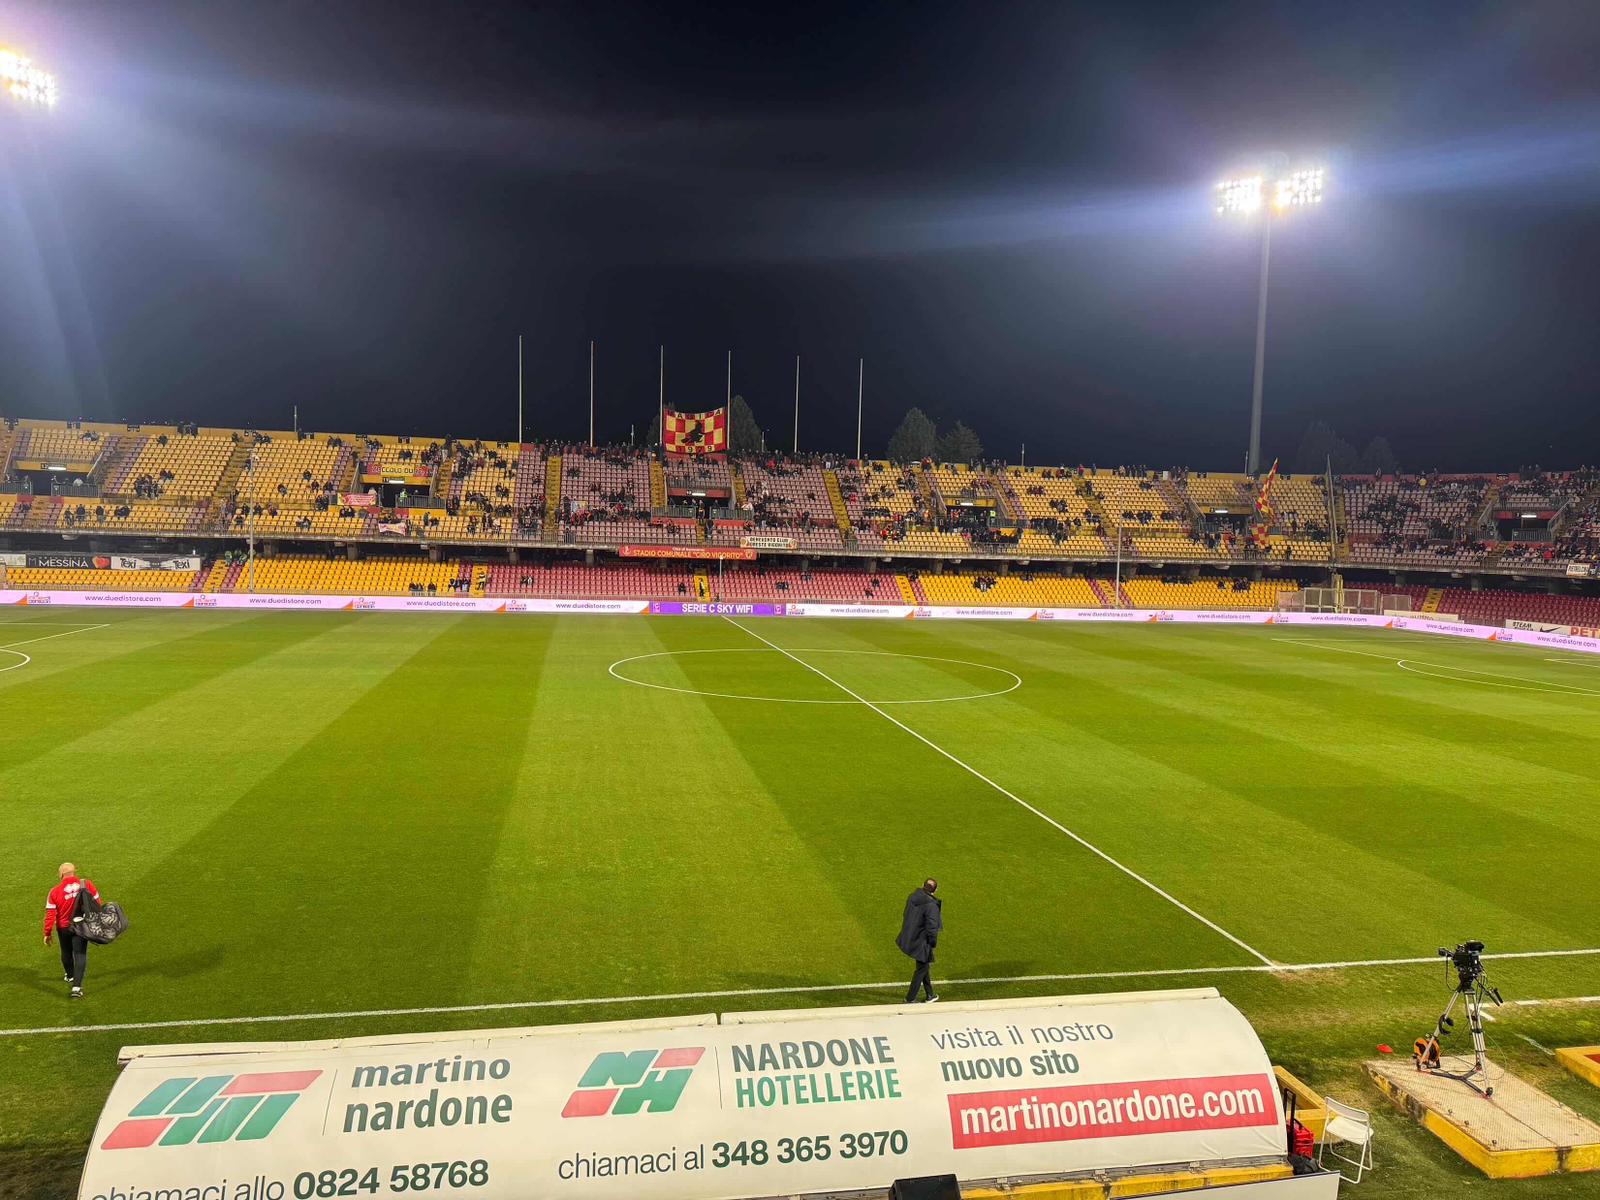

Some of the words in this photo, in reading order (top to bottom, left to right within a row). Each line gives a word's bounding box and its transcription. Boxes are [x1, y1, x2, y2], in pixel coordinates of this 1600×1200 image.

[39, 558, 89, 568] MESSINA
[633, 549, 656, 557] STADIO
[657, 550, 691, 558] COMUNALE
[249, 597, 322, 605] www.duedistore.com
[555, 602, 621, 610] www.duedistore.com
[682, 603, 707, 613] SERIE
[709, 604, 714, 613] C
[716, 604, 736, 613] SKY
[736, 605, 753, 613] WIFI
[1512, 621, 1532, 629] STEAM
[930, 1026, 1003, 1051] visita
[1008, 1023, 1025, 1045] il
[1030, 1020, 1115, 1044] nostro
[351, 1054, 511, 1088] martino
[731, 1036, 895, 1073] NARDONE
[940, 1055, 1024, 1082] nuovo
[1029, 1049, 1080, 1077] sito
[735, 1068, 902, 1109] HOTELLERIE
[342, 1088, 513, 1133] nardone
[960, 1086, 1265, 1135] martinonardone.com
[558, 1146, 677, 1180] chiamaci
[683, 1144, 705, 1172] al
[711, 1138, 769, 1168] 348
[776, 1135, 831, 1164] 365
[839, 1129, 908, 1159] 3970
[92, 1179, 227, 1200] himaci
[235, 1175, 285, 1200] allo
[293, 1166, 380, 1199] 0824
[389, 1158, 489, 1193] 58768
